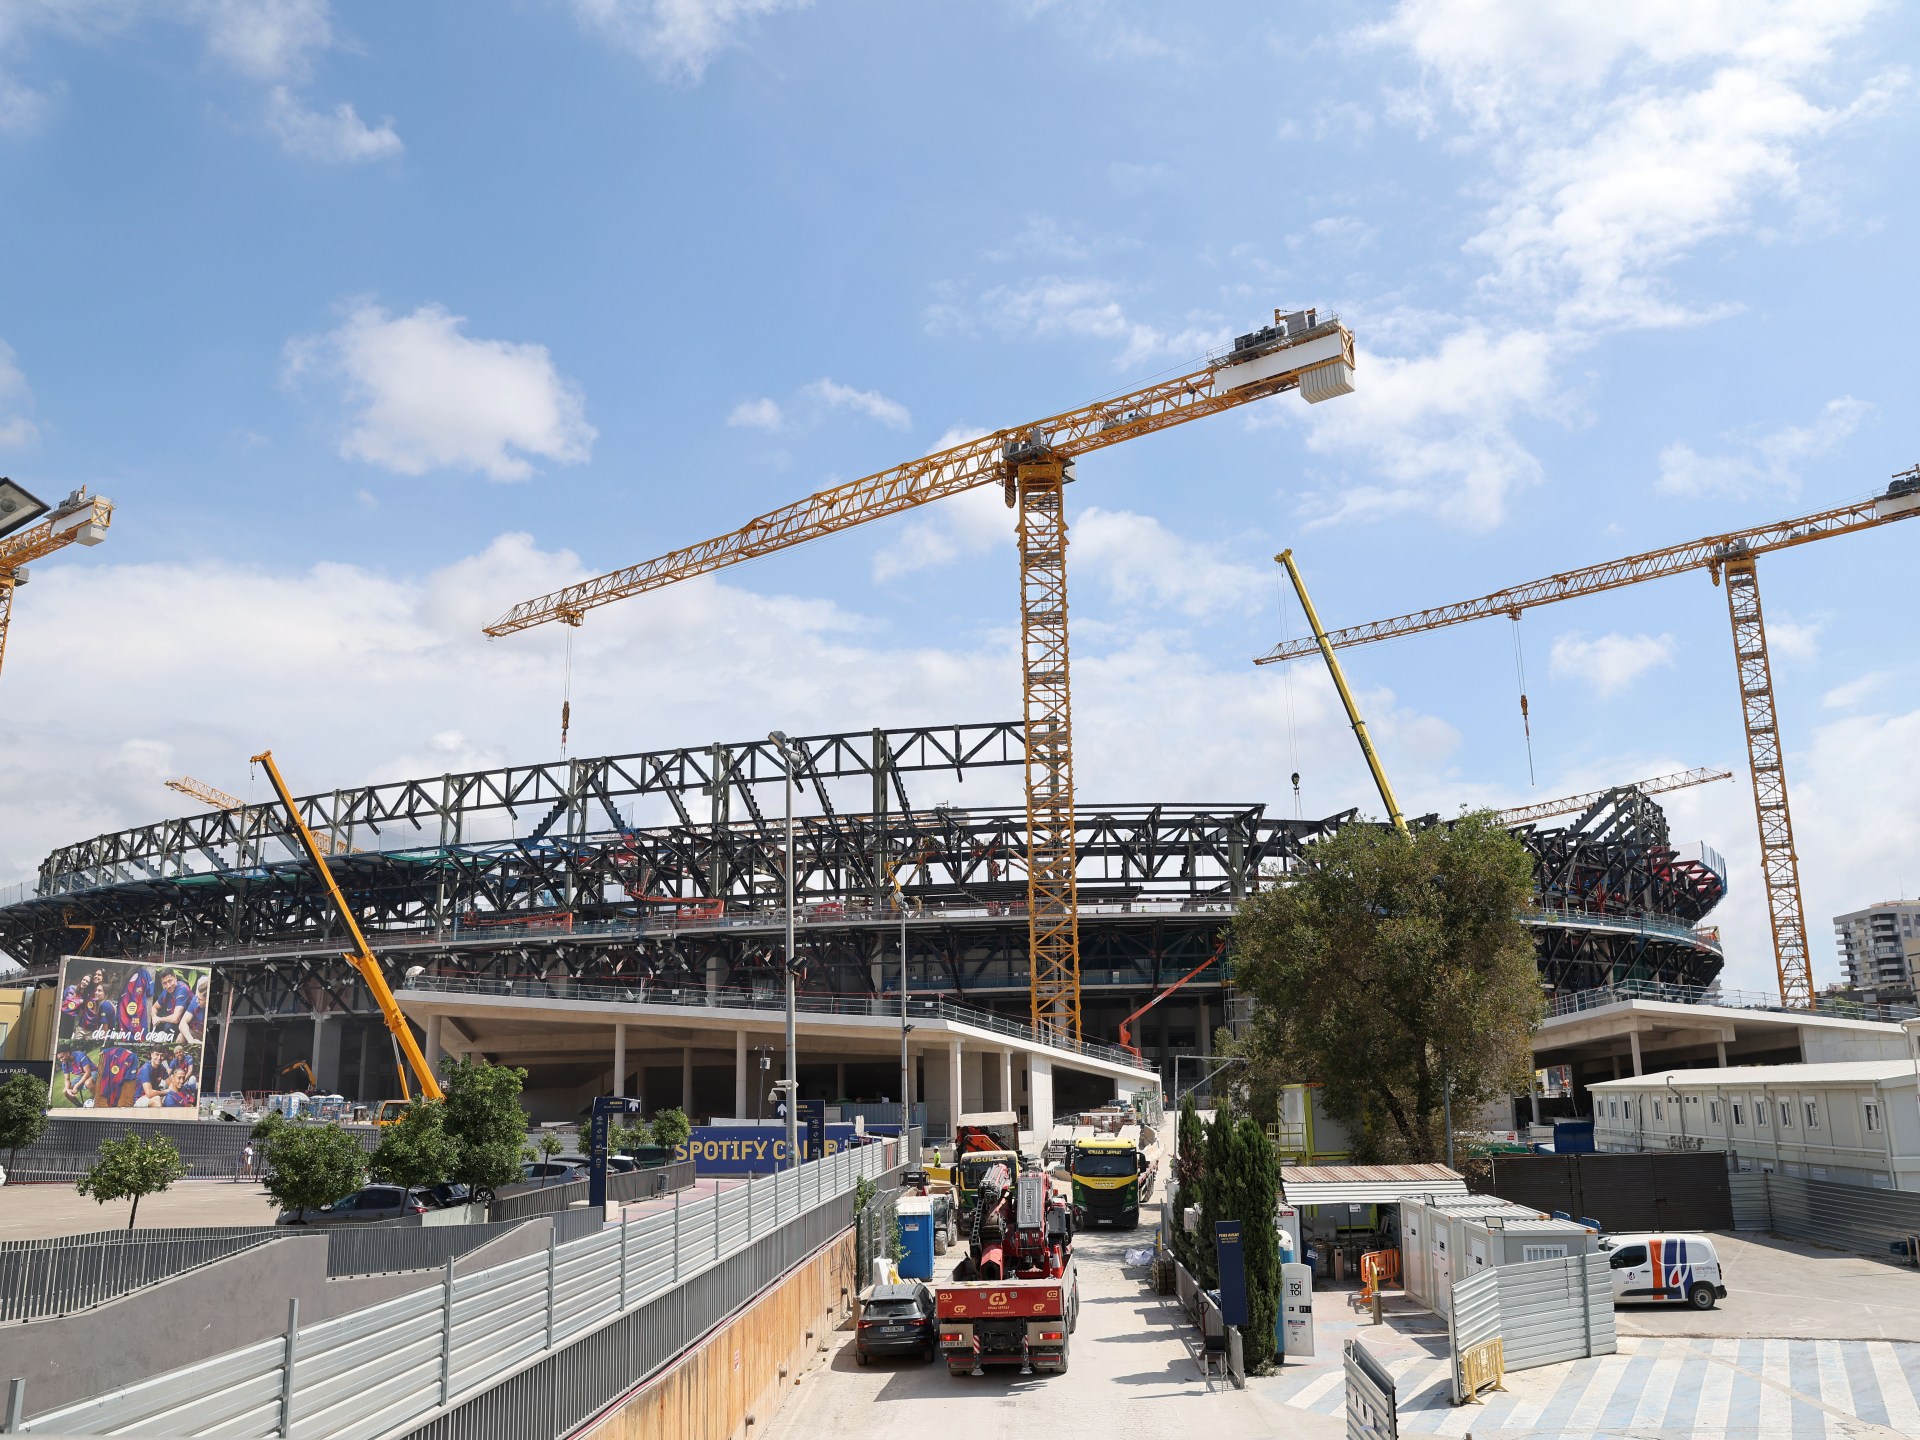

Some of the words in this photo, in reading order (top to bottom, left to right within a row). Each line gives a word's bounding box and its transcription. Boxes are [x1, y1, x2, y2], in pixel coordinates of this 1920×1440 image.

[92, 1024, 131, 1047] definim
[134, 1028, 145, 1041] el
[146, 1027, 175, 1042] demà
[675, 1140, 768, 1161] SPOTIFY
[773, 1140, 839, 1161] CP
